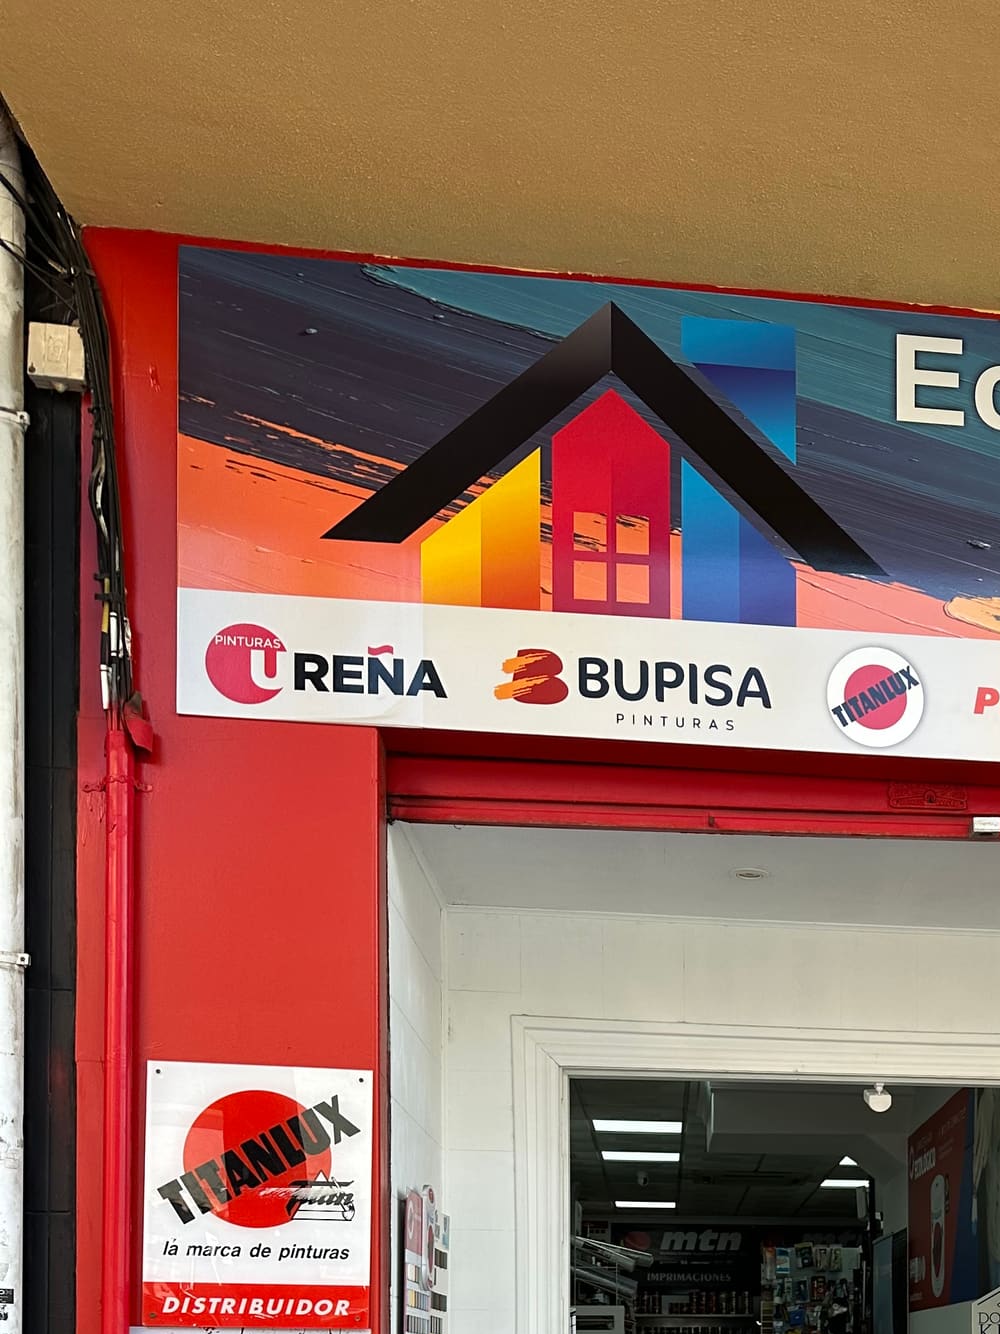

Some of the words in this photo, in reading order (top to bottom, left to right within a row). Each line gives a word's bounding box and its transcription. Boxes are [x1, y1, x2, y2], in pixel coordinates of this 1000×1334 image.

[214, 634, 281, 650] PINTURAS
[578, 656, 773, 709] BUPISA
[831, 665, 920, 728] TITANLUX
[616, 713, 736, 732] PINTURAS
[157, 1094, 361, 1226] TITANLUX
[163, 1240, 178, 1256] la
[186, 1244, 241, 1258] marca
[250, 1243, 271, 1258] de
[278, 1244, 350, 1261] pinturas
[661, 1230, 742, 1251] mtn
[647, 1271, 732, 1283] IMPRIMACIONES
[162, 1297, 351, 1316] DISTRIBUIDOR
